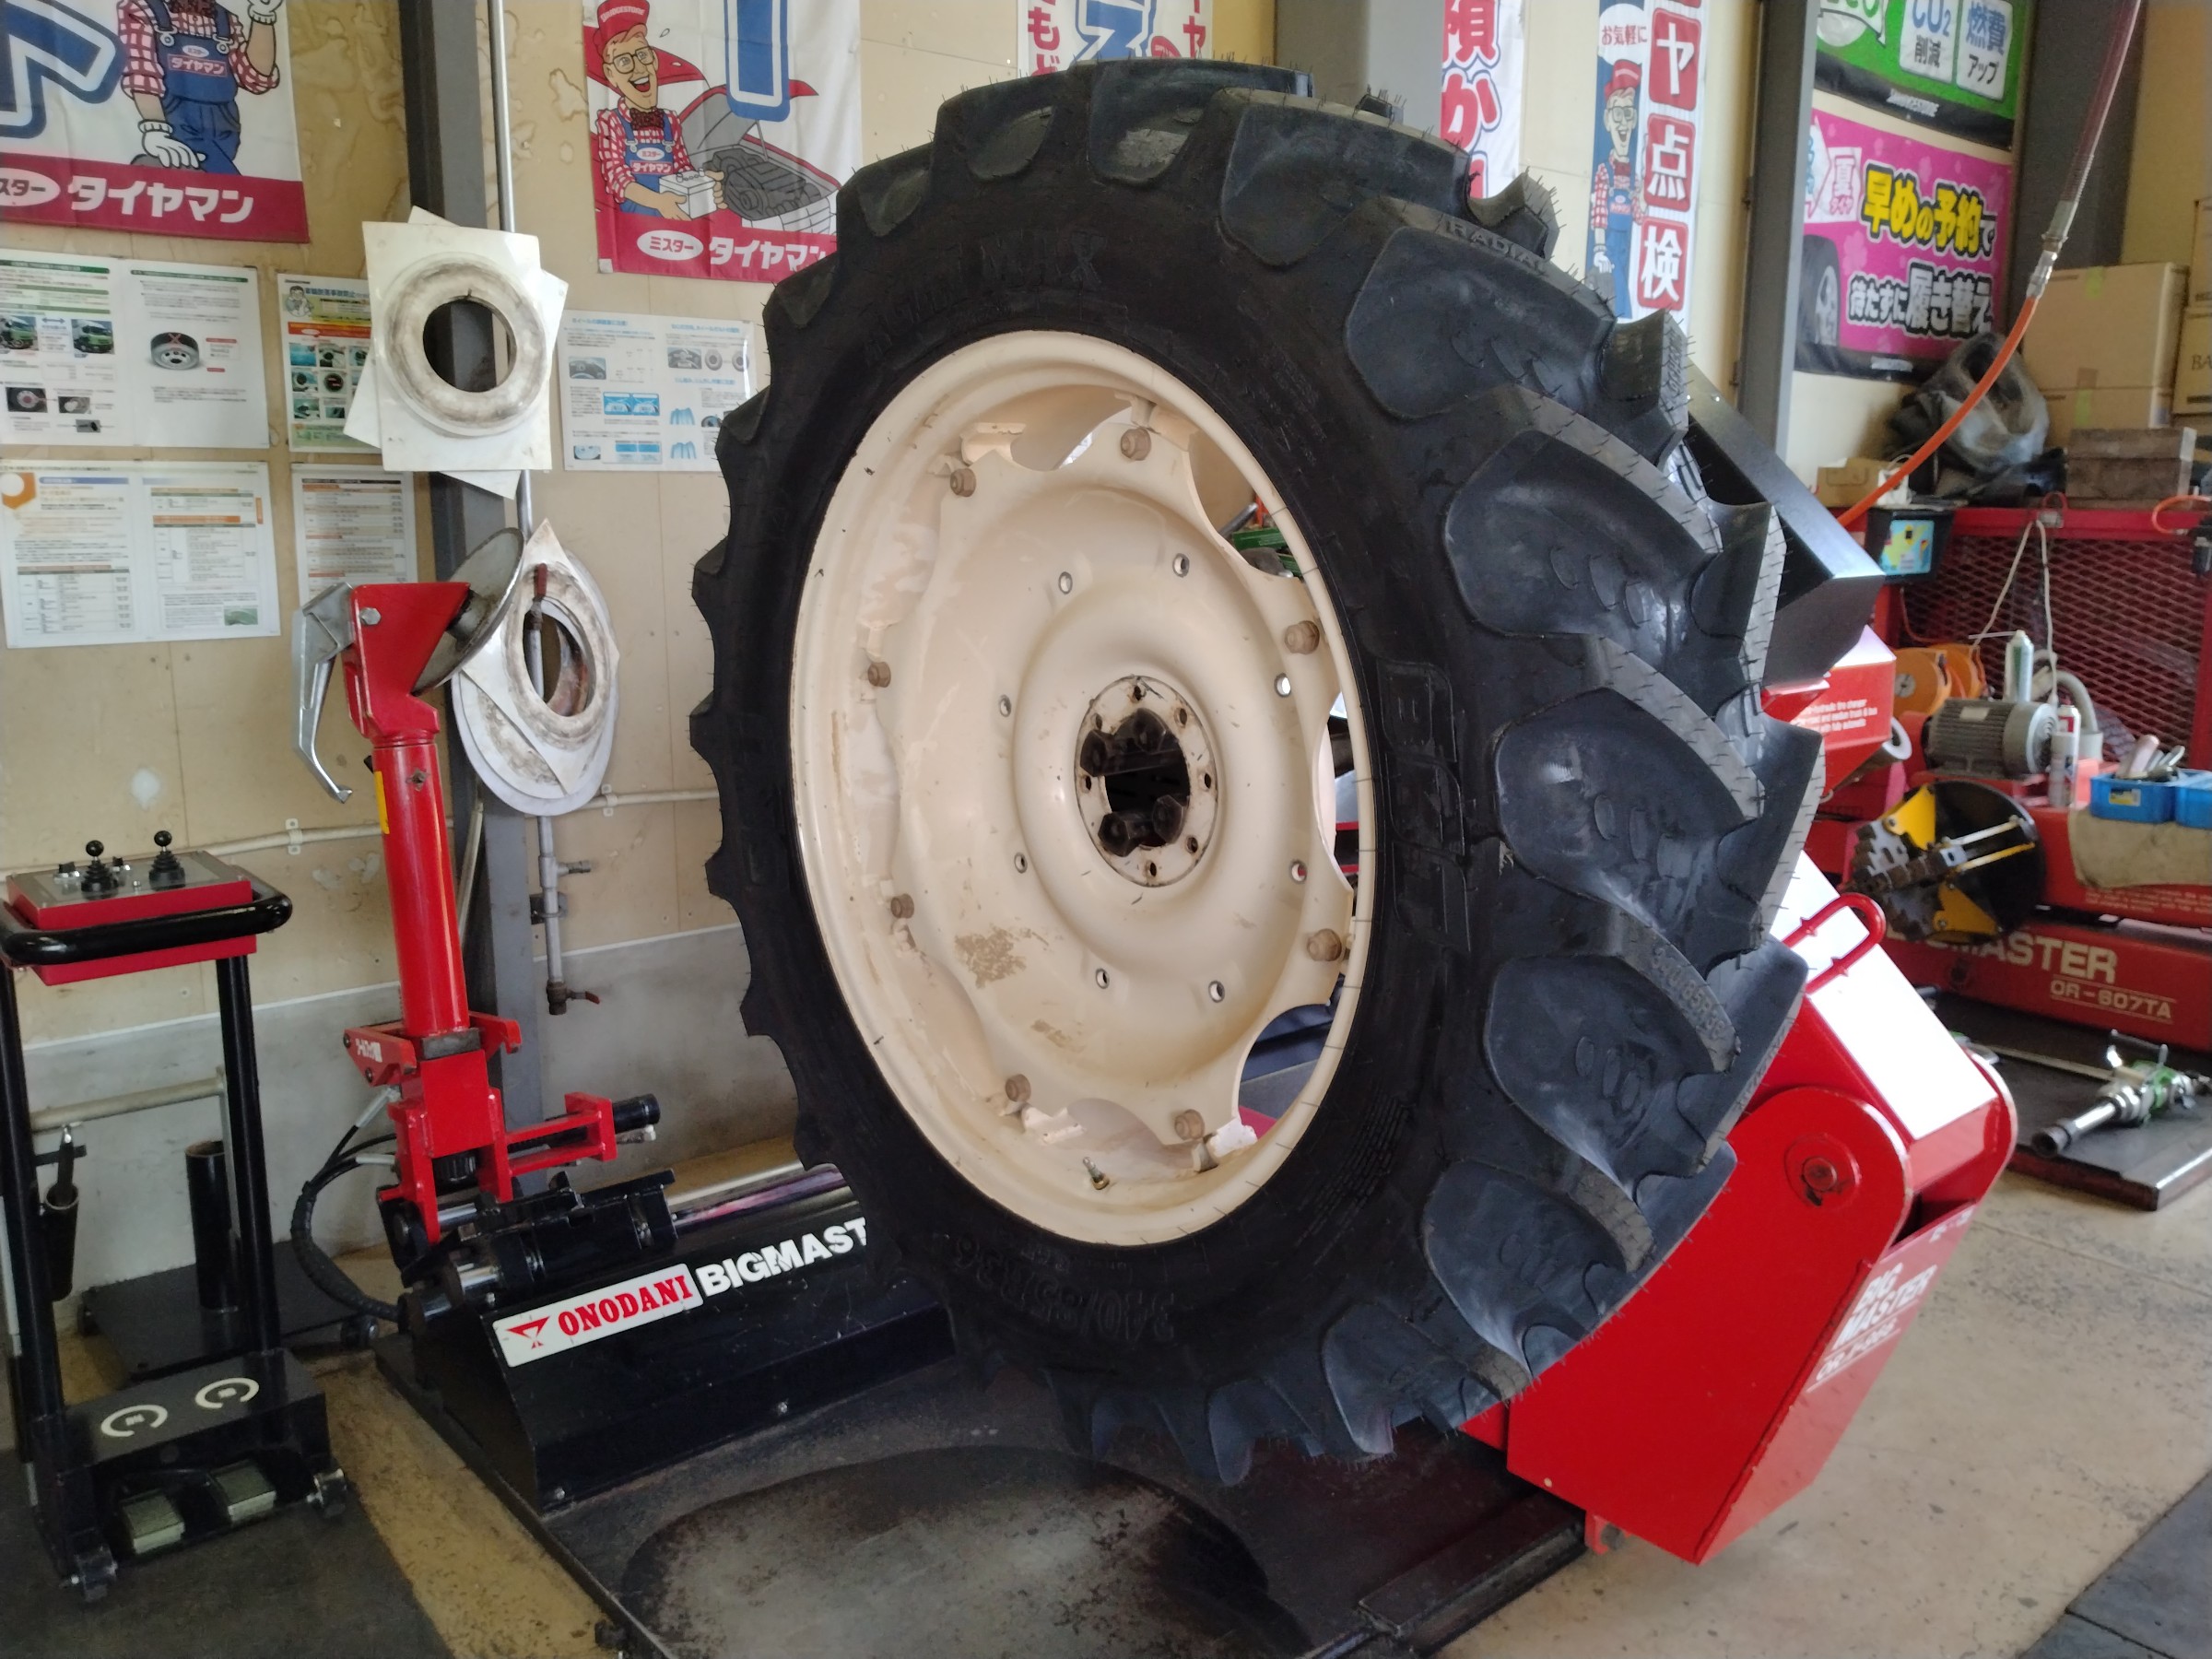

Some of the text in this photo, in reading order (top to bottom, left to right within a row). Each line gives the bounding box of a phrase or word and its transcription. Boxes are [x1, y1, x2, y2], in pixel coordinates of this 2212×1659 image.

[1601, 24, 1648, 46] お気軽に
[1966, 1, 2006, 55] 燃費
[171, 58, 226, 75] タイヤマン
[1967, 53, 2000, 85] アップ
[632, 162, 672, 174] タイヤマン
[67, 175, 254, 223] タイヤマン
[1862, 164, 1997, 257] 早めの予約で
[649, 236, 694, 253] ミスター
[558, 1218, 867, 1337] ONODANI BIGMAST
